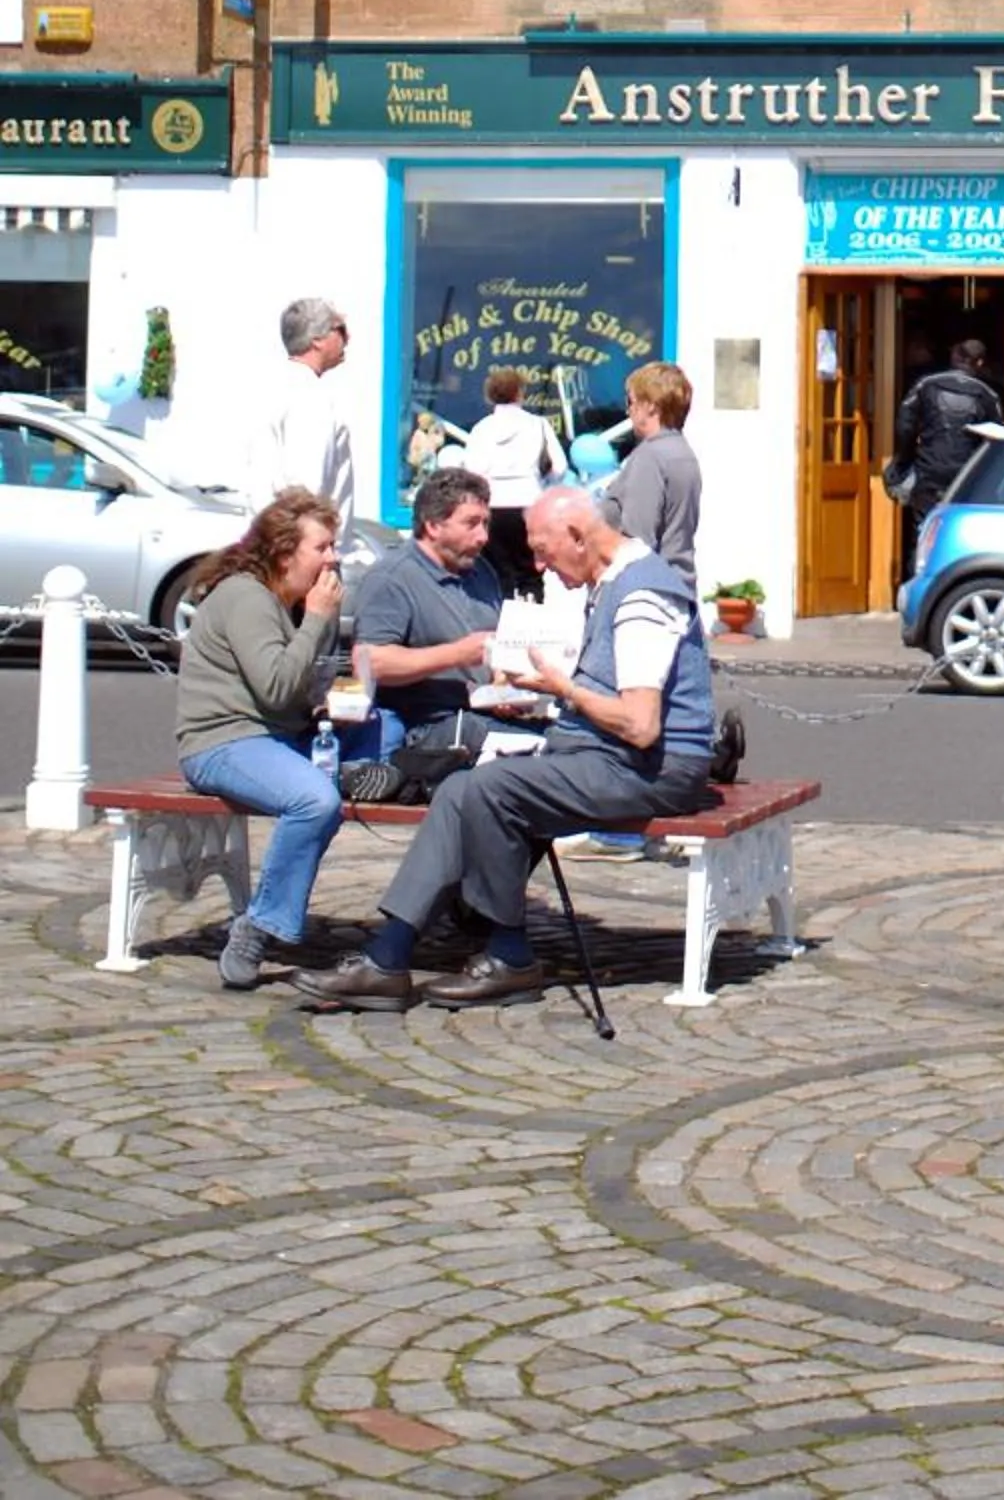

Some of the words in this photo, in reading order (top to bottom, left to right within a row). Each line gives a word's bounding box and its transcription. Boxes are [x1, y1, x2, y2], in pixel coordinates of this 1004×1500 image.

[386, 61, 425, 81] The
[387, 83, 449, 102] Award
[559, 65, 941, 124] Anstruther
[387, 104, 474, 129] Winning
[1, 116, 132, 143] aurant
[871, 177, 998, 200] CHIPSHOP
[853, 205, 888, 231] OF
[893, 205, 945, 231] THE
[848, 232, 921, 249] 2006
[477, 277, 588, 298] Awarded
[415, 312, 470, 356] Fish
[478, 304, 505, 329] &
[512, 299, 580, 332] Chip
[585, 310, 652, 359] Shop
[453, 337, 481, 370] of
[490, 331, 537, 356] the
[549, 332, 612, 366] Year
